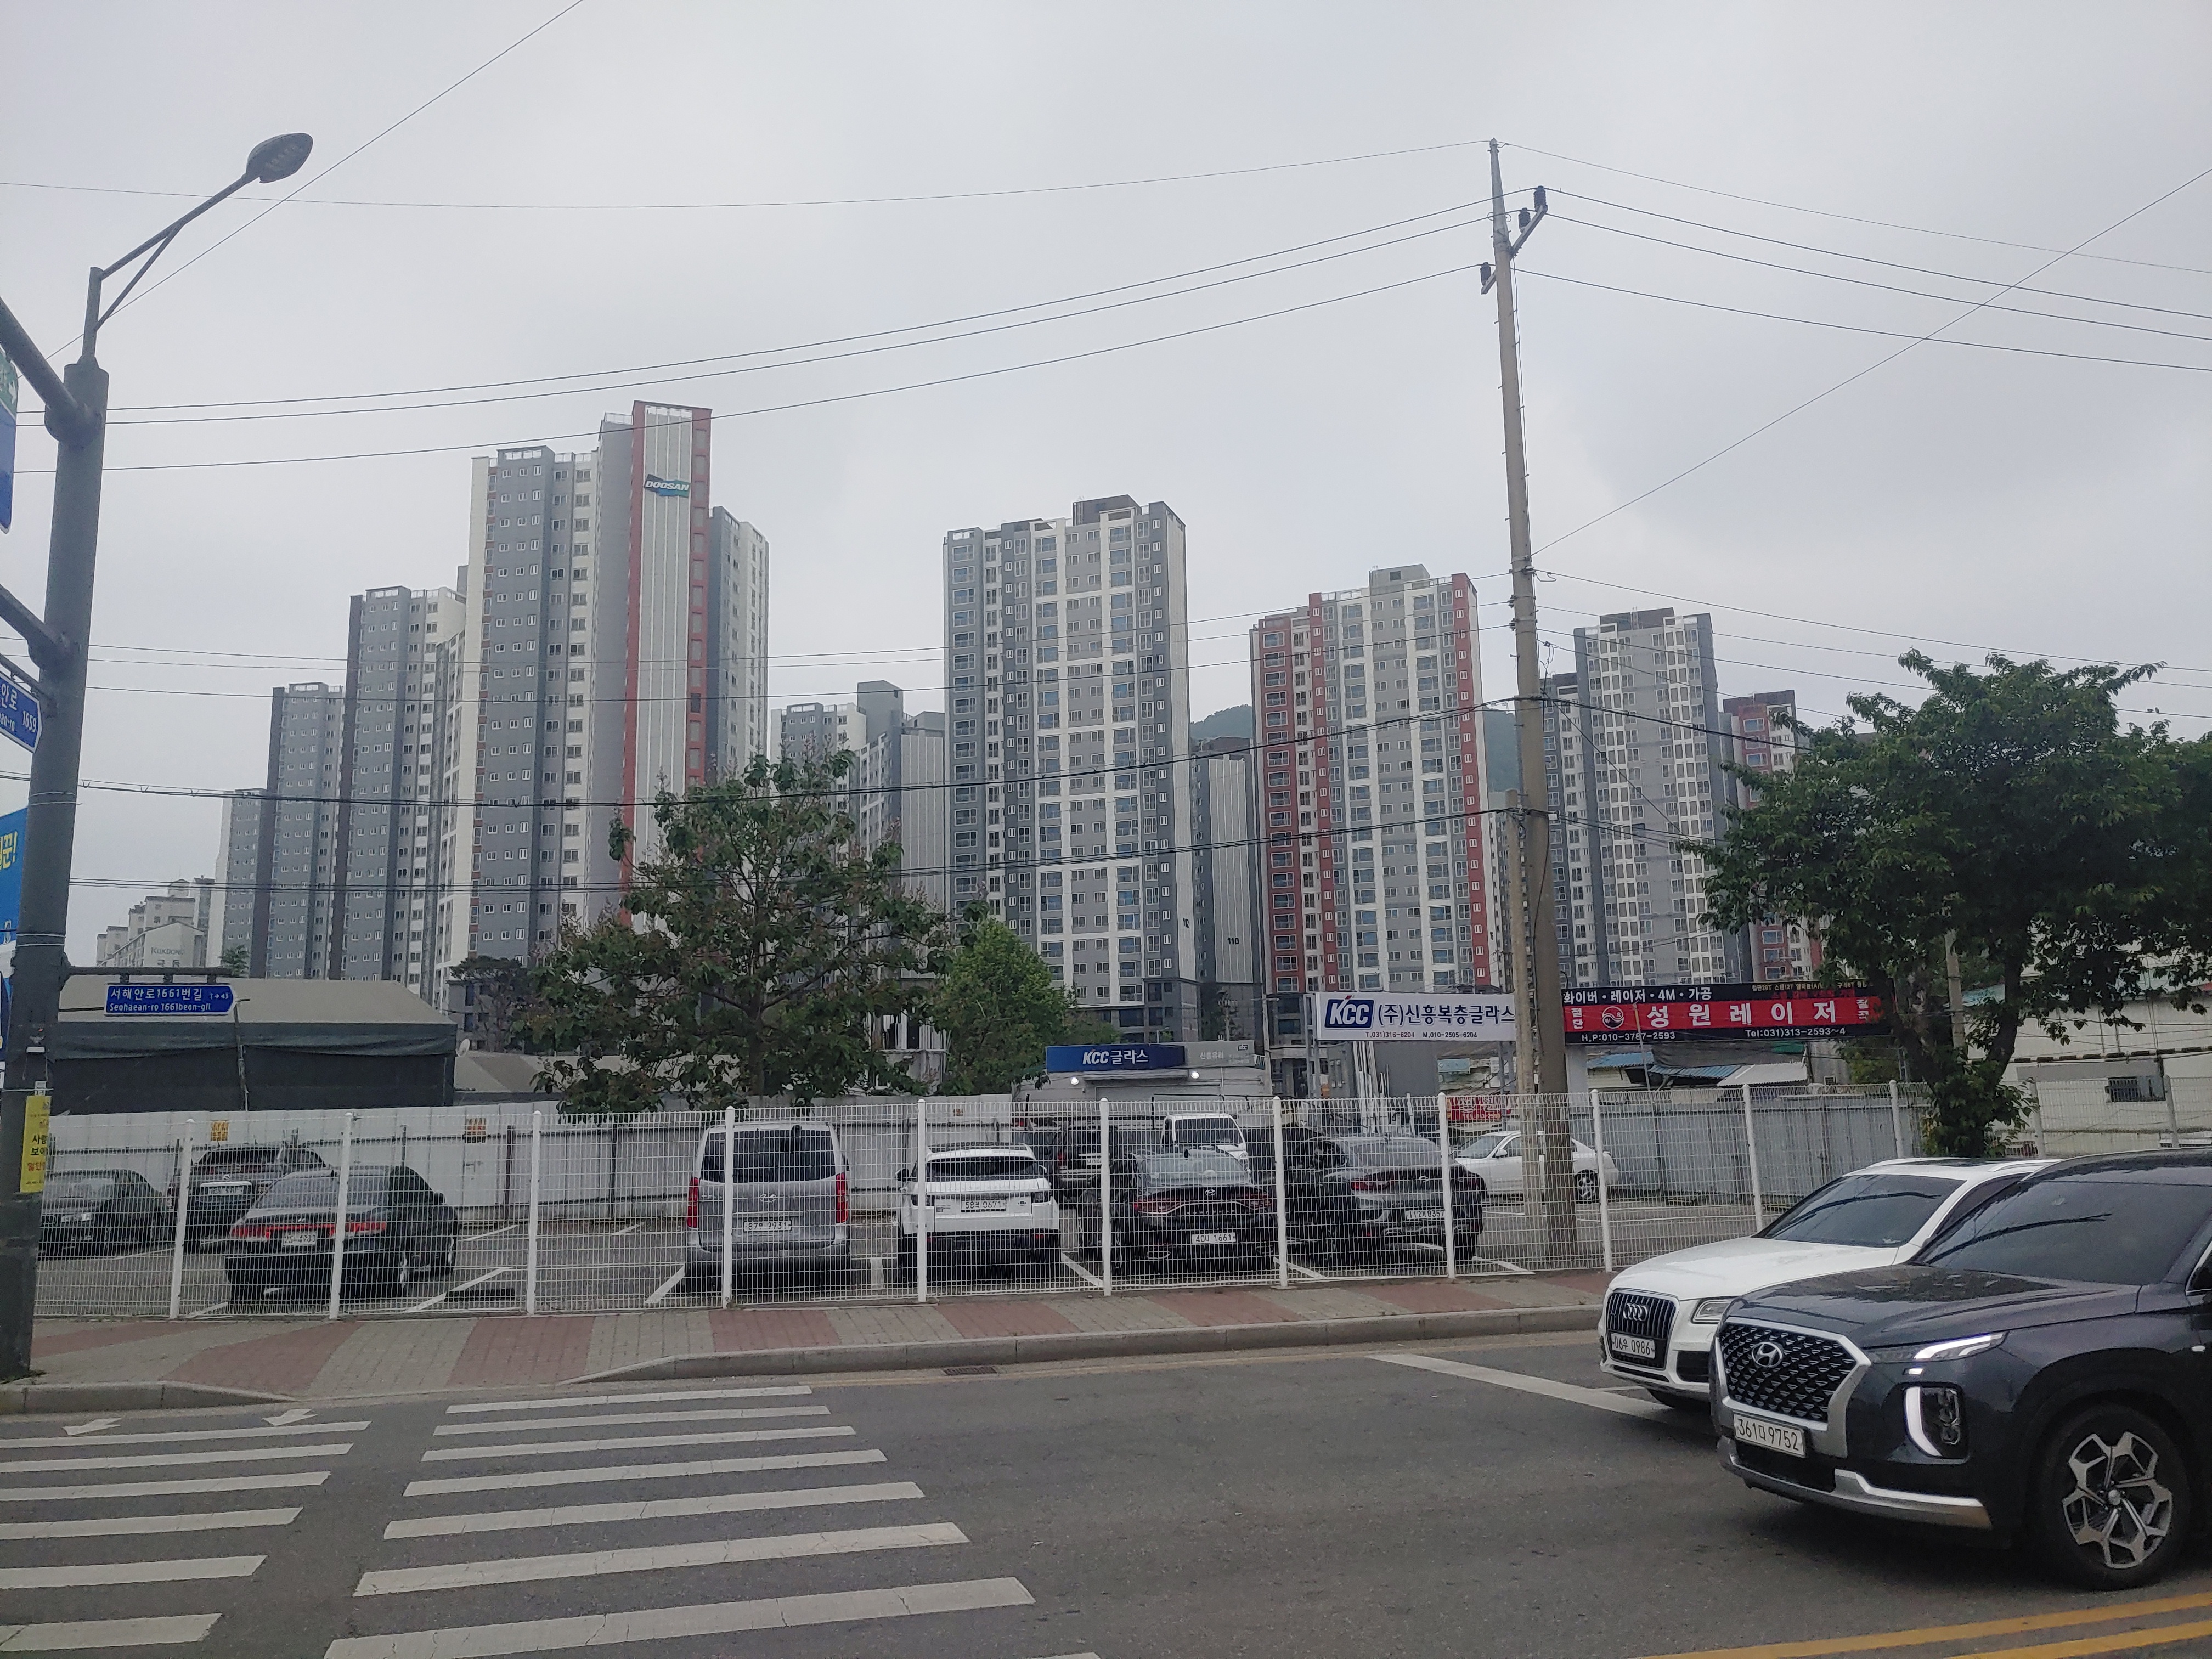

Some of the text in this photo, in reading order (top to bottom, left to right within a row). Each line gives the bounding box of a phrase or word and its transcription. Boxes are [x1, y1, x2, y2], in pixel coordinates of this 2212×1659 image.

[645, 481, 690, 490] DOOSAN
[22, 710, 37, 733] 1659
[110, 988, 202, 1001] 서해안로1661번길
[1564, 987, 1712, 1005] 화이버 레이저 4M 가공
[1329, 996, 1370, 1025] KCC
[1378, 1005, 1515, 1025] (주)신흥복층글라스
[1631, 1339, 1651, 1355] 0986
[1768, 1426, 1799, 1451] 9752
